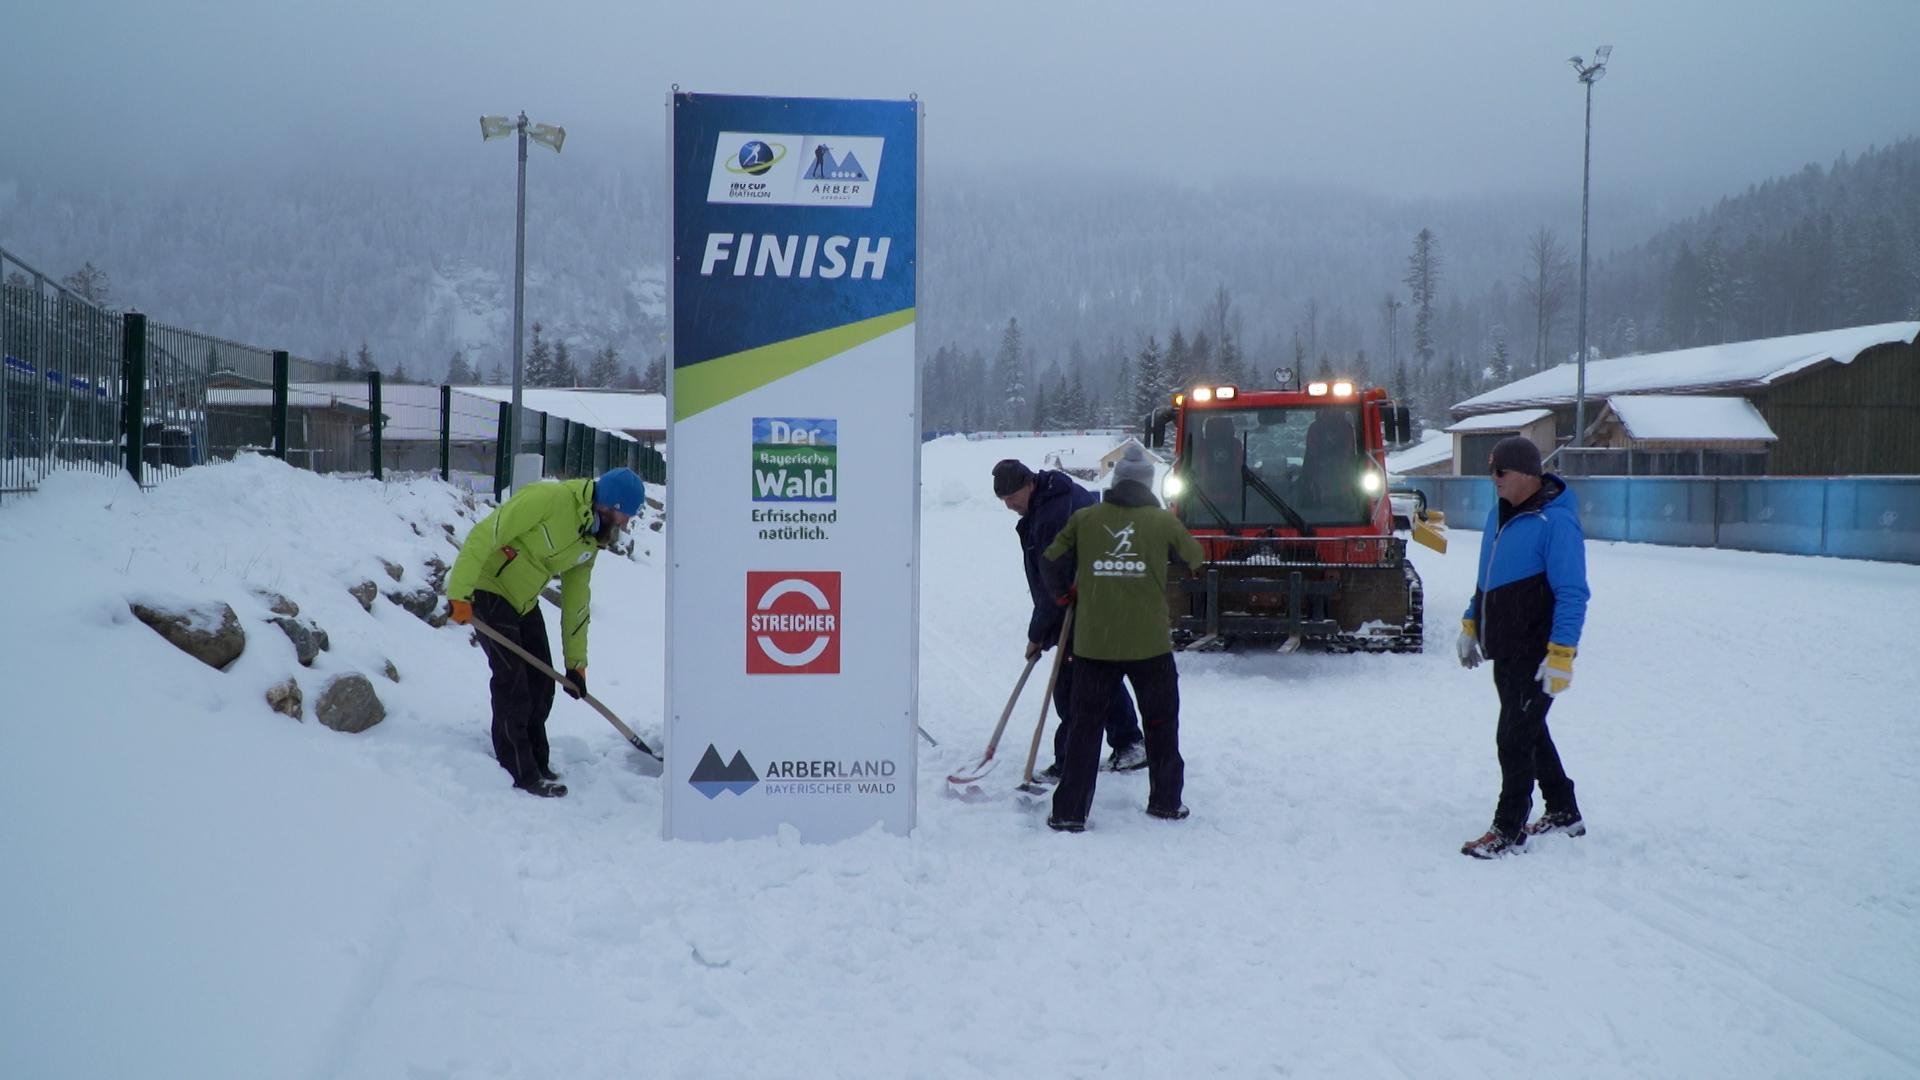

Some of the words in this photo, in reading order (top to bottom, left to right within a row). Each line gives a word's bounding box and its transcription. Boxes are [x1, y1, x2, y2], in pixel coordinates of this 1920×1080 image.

[729, 190, 771, 198] BIATHLON
[812, 184, 860, 194] ARBER
[700, 233, 891, 279] FINISH
[770, 421, 821, 445] Der
[760, 453, 829, 466] Bayerische
[755, 469, 833, 498] Wald
[752, 509, 837, 522] Erfrischend
[759, 526, 829, 540] natürlich.
[751, 614, 835, 632] STREICHER
[766, 760, 896, 778] ARBERLAND
[765, 783, 852, 794] BAYERISCHER
[857, 783, 896, 794] WALD
